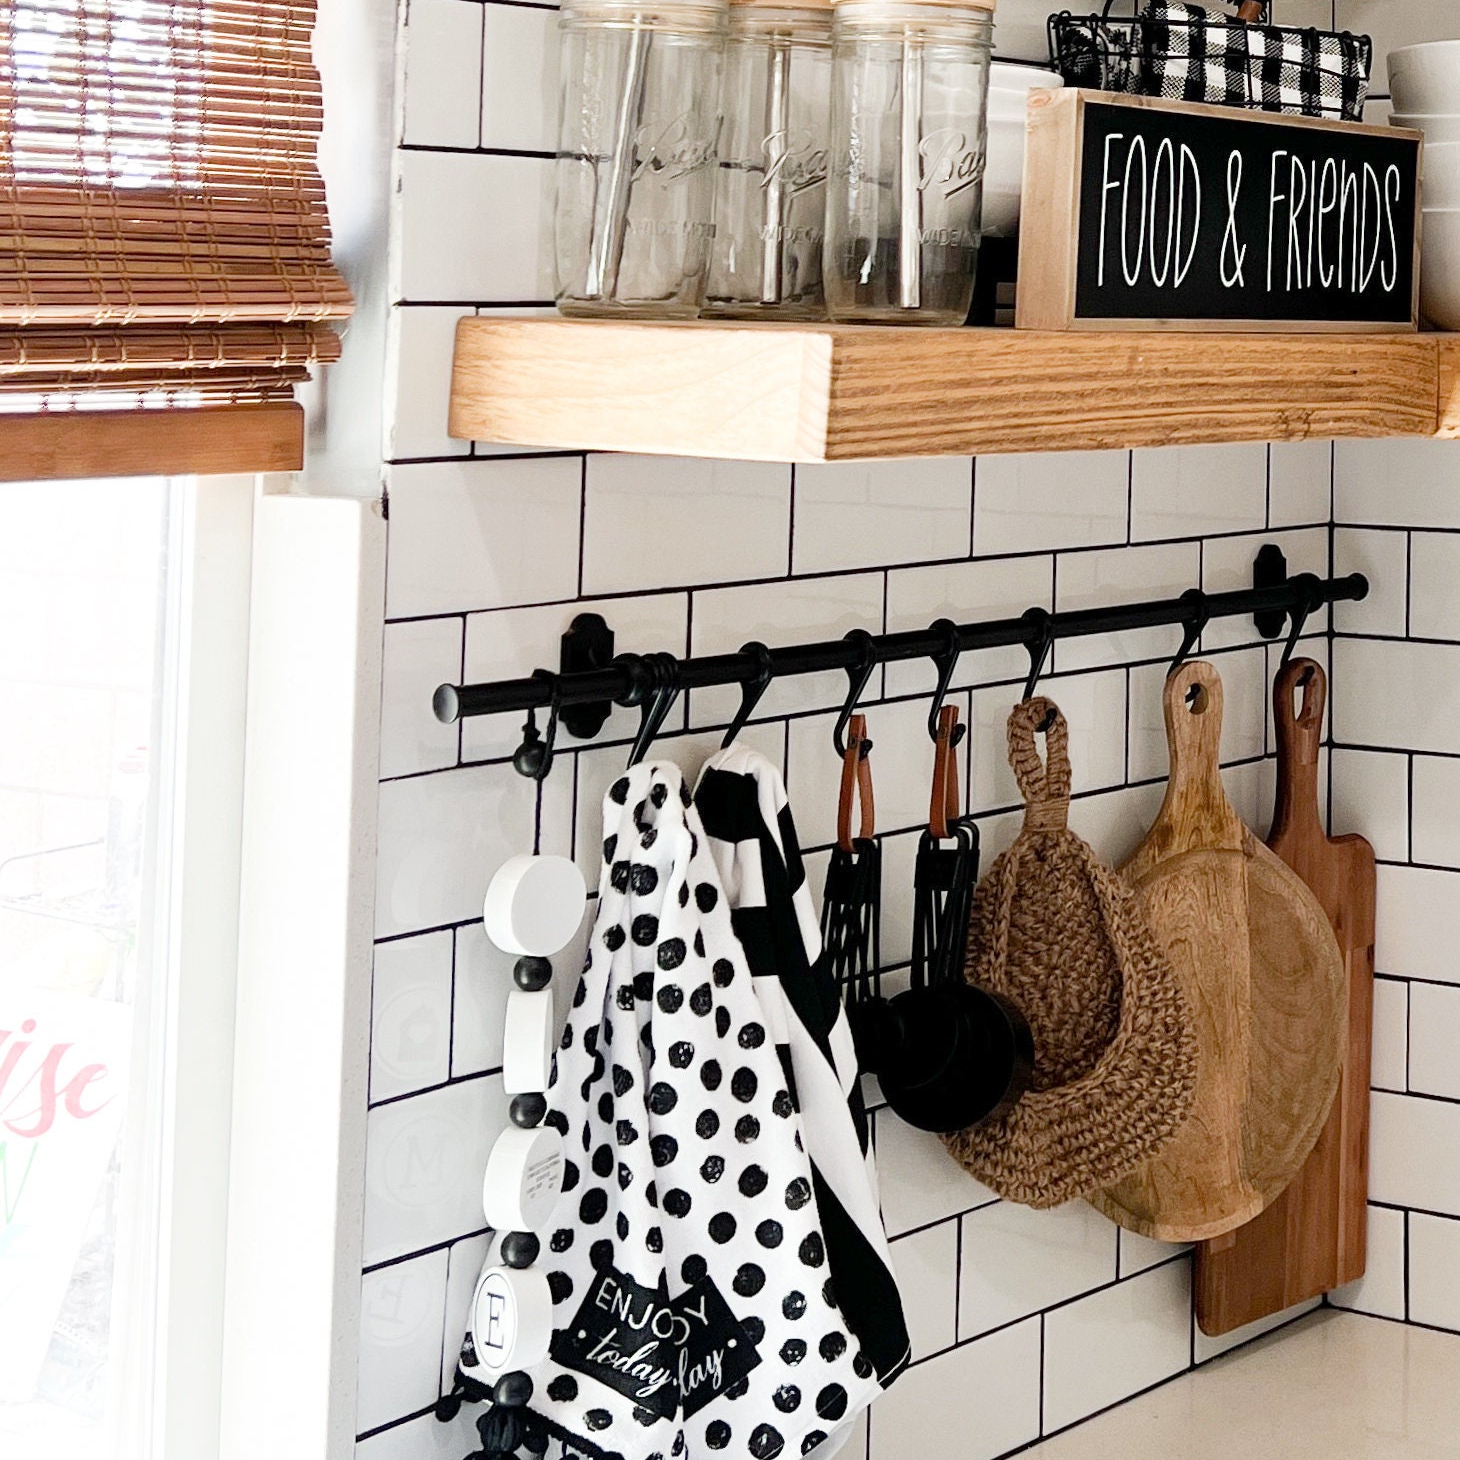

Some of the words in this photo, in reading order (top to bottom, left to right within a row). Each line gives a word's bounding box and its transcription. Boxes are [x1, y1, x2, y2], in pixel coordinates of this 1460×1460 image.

[1098, 133, 1200, 289] FOOD
[1220, 149, 1247, 288] &
[485, 1292, 505, 1349] E
